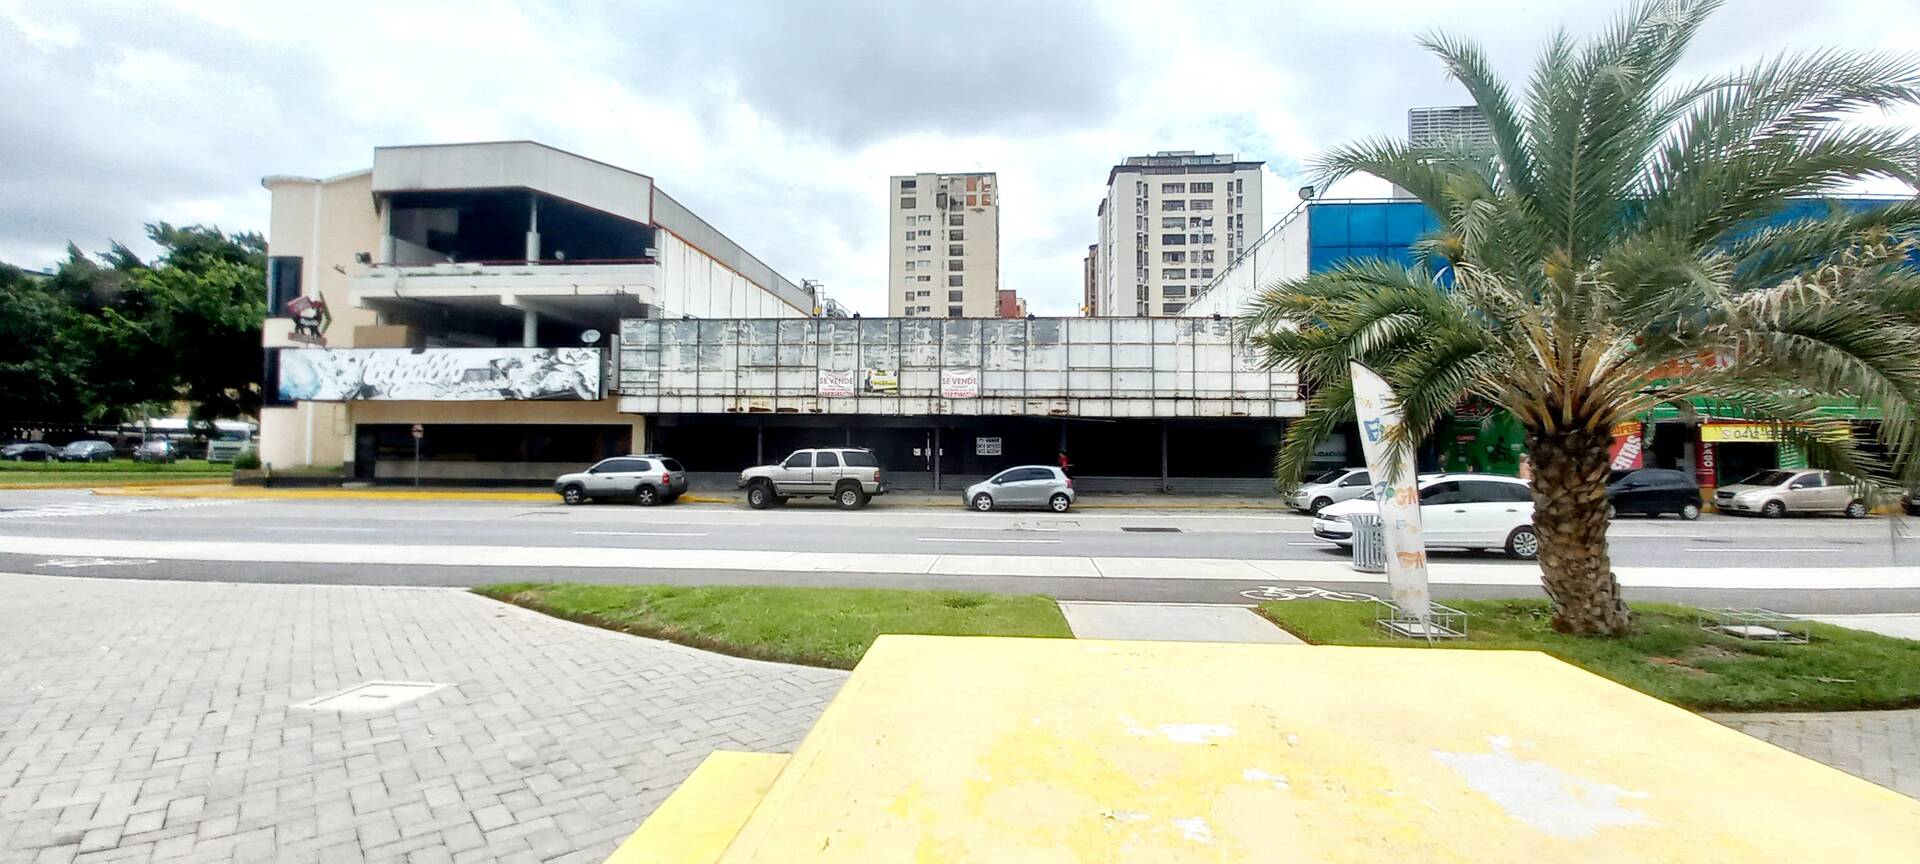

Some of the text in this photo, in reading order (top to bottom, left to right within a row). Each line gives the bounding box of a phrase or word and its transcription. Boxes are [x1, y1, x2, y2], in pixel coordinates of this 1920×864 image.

[819, 377, 854, 385] SE VENDE
[942, 377, 977, 385] SE VENDE
